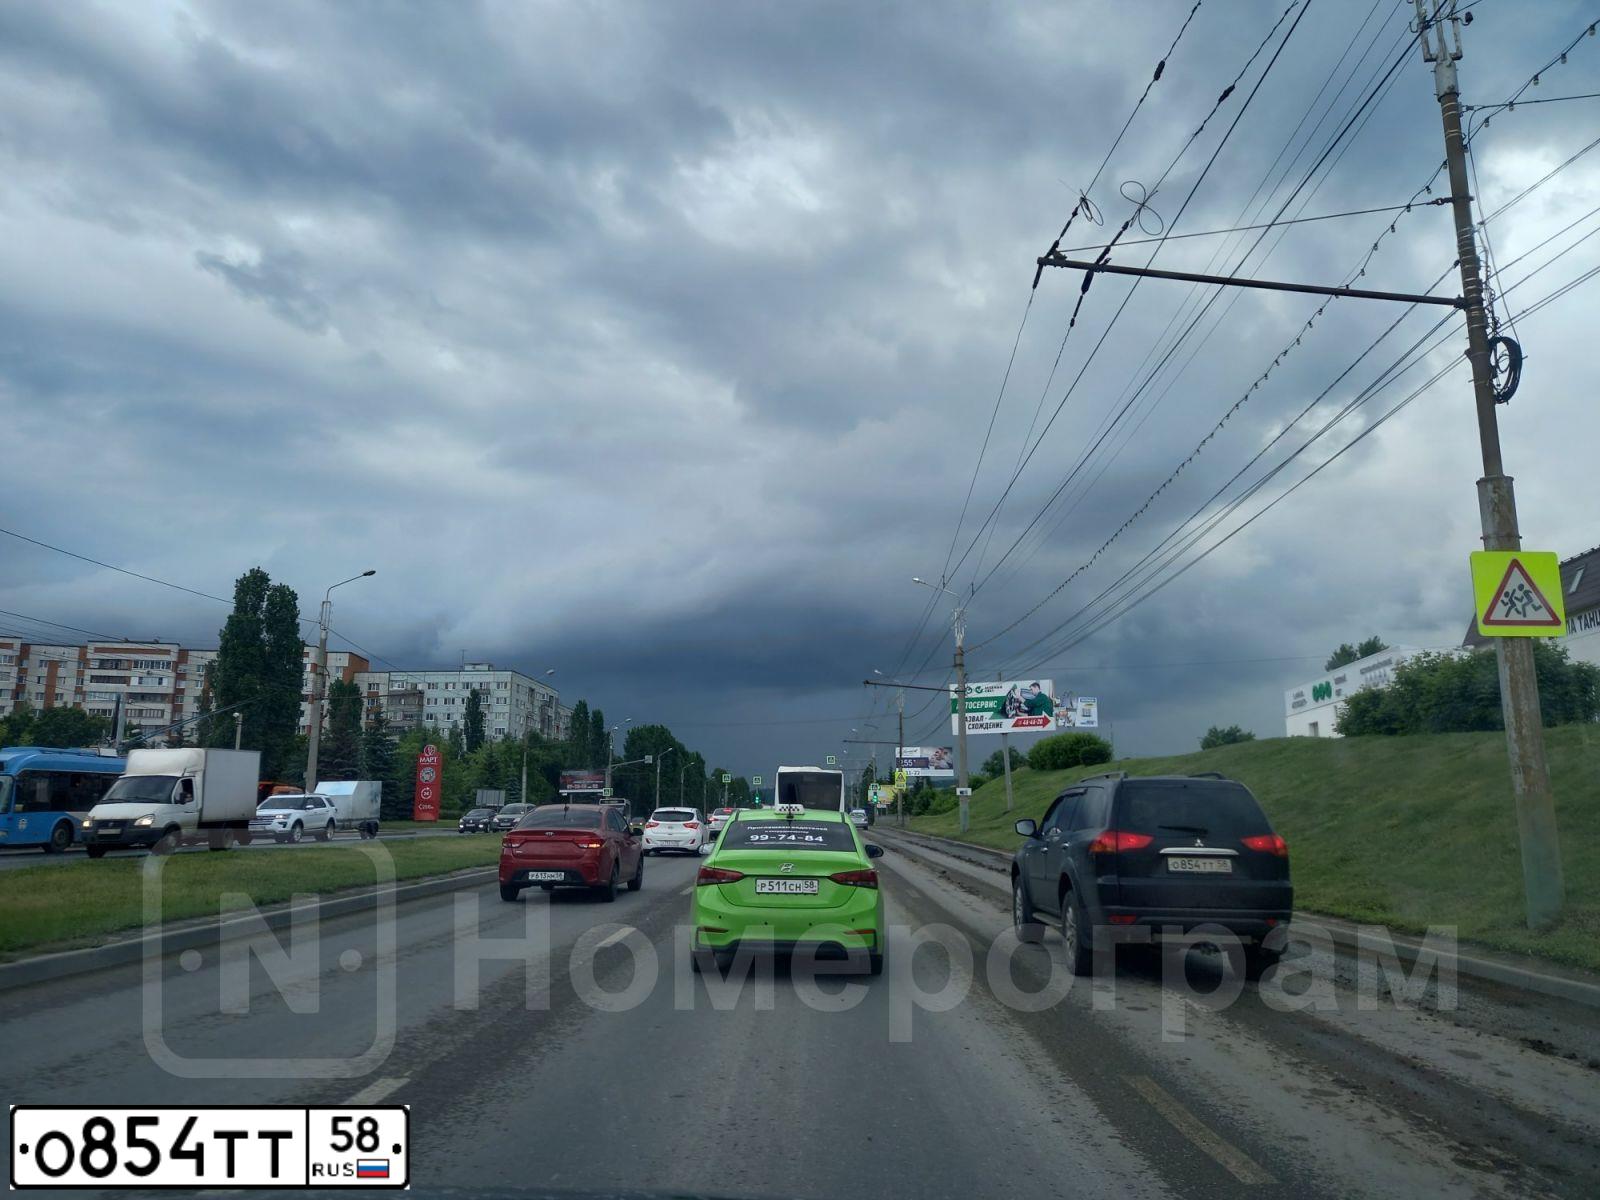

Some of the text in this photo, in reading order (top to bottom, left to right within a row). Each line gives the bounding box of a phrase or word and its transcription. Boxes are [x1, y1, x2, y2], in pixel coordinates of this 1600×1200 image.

[967, 721, 1003, 730] СХОЖДЕНИЕ
[750, 834, 823, 842] 99-74-84
[1172, 859, 1214, 870] О854ТТ
[760, 879, 815, 891] Р511СН 58
